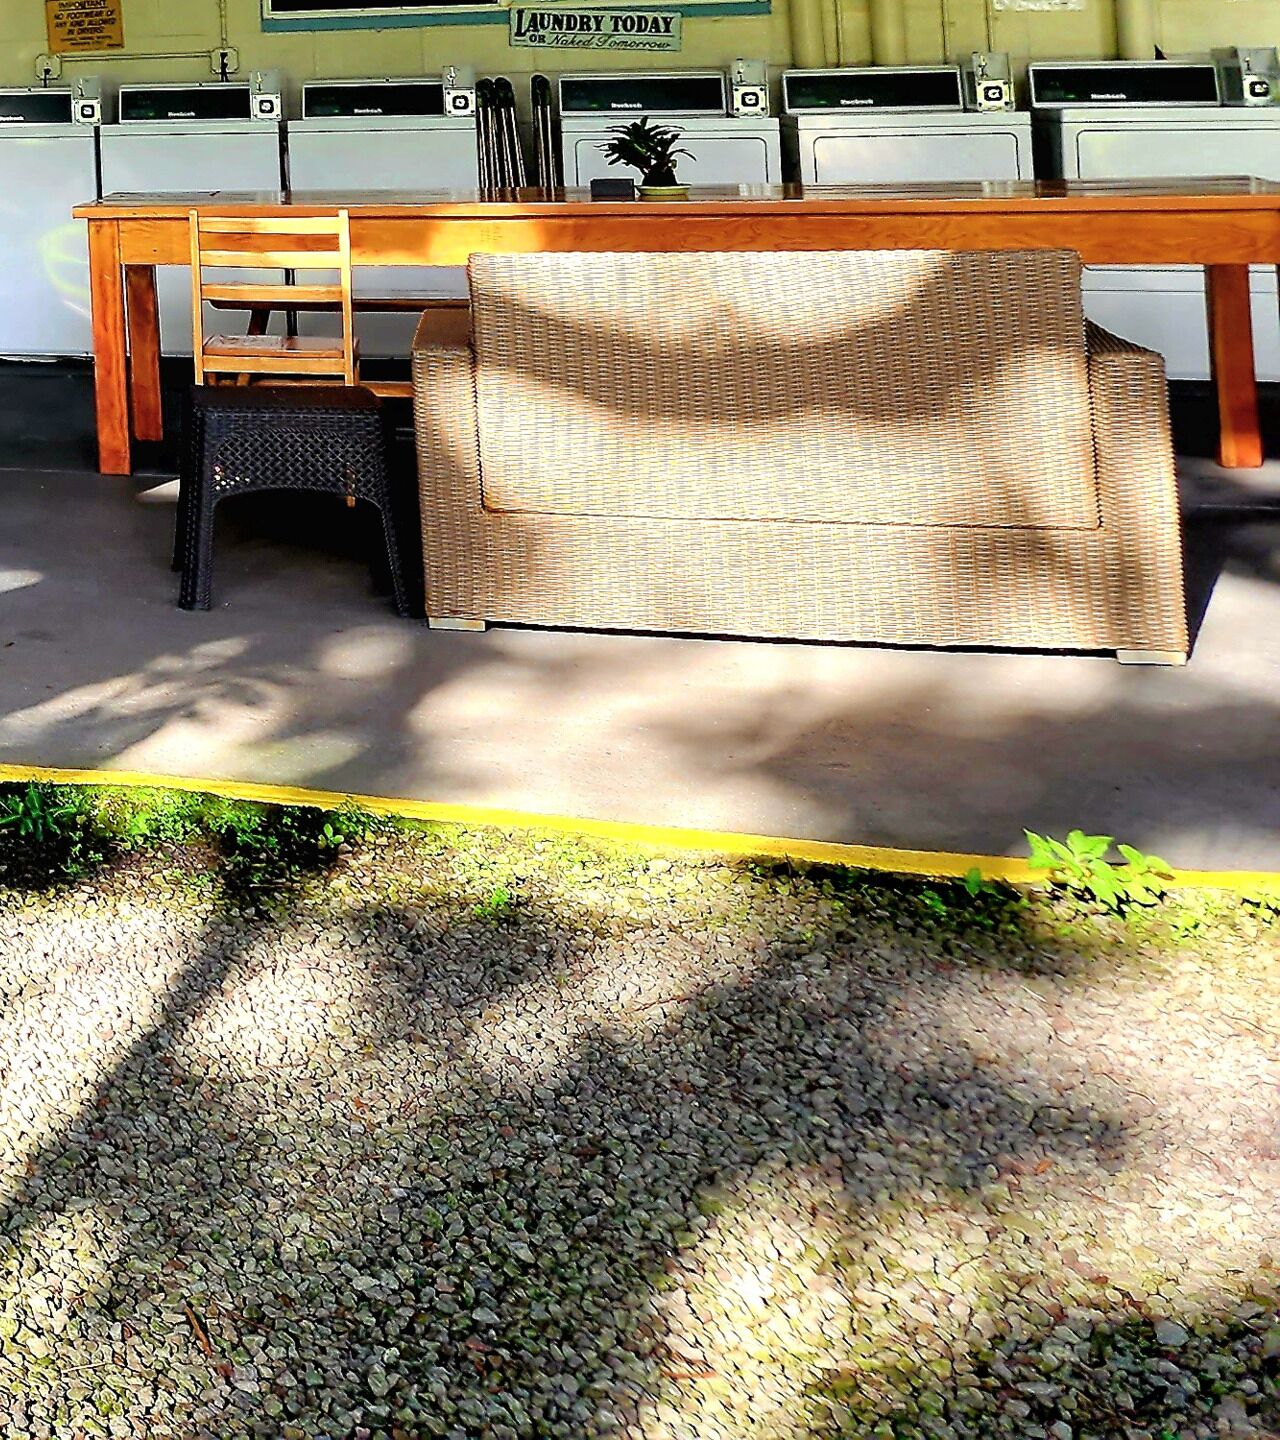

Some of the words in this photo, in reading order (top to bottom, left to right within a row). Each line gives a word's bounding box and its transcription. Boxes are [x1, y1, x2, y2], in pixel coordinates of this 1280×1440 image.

[514, 8, 604, 37] LAUNDRY
[610, 14, 675, 33] TODAY
[529, 34, 546, 44] OR
[547, 35, 595, 47] Naked
[595, 34, 672, 48] Tomorrow
